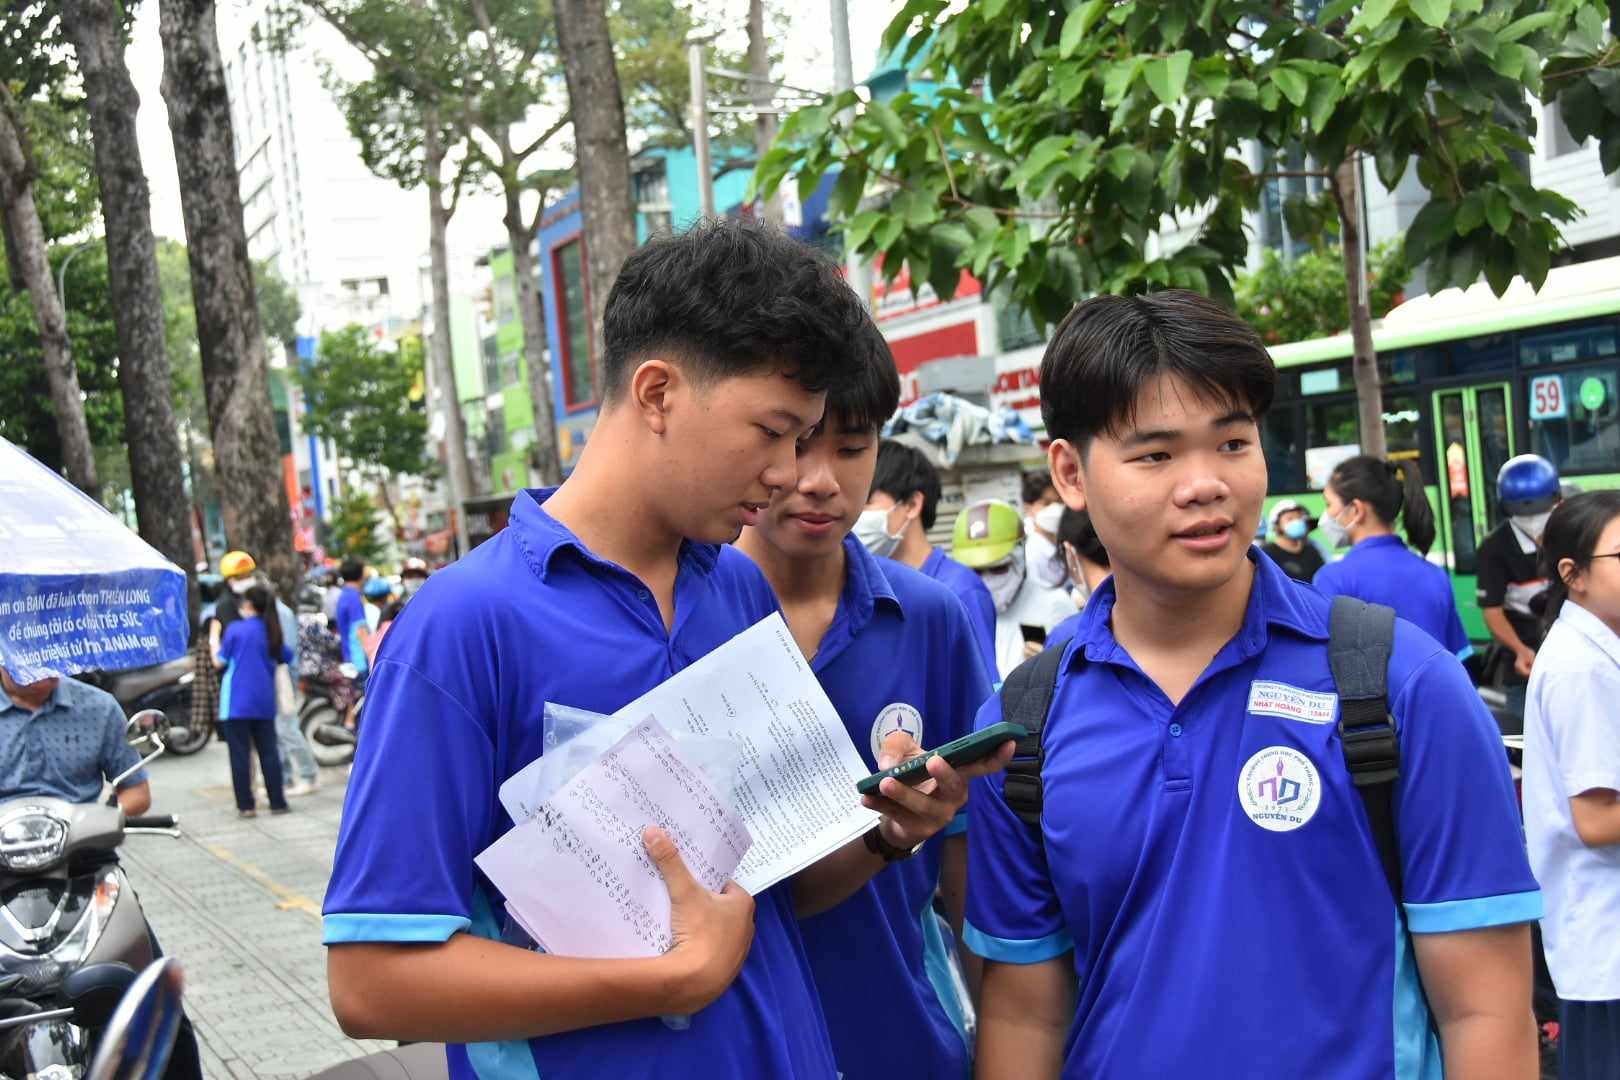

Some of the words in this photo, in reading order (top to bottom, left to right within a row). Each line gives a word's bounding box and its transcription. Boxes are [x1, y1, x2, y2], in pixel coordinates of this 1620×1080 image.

[1535, 380, 1560, 415] 59
[26, 594, 46, 615] BẠN
[46, 591, 59, 610] đã
[126, 588, 151, 605] LONG
[9, 620, 22, 641] để
[24, 620, 49, 641] chúng
[49, 616, 63, 636] tôi
[63, 615, 75, 633] có
[98, 609, 119, 629] TIẾP
[120, 610, 143, 628] SỨC
[70, 638, 84, 657] tử
[112, 632, 141, 652] NĂM
[140, 635, 160, 652] qua
